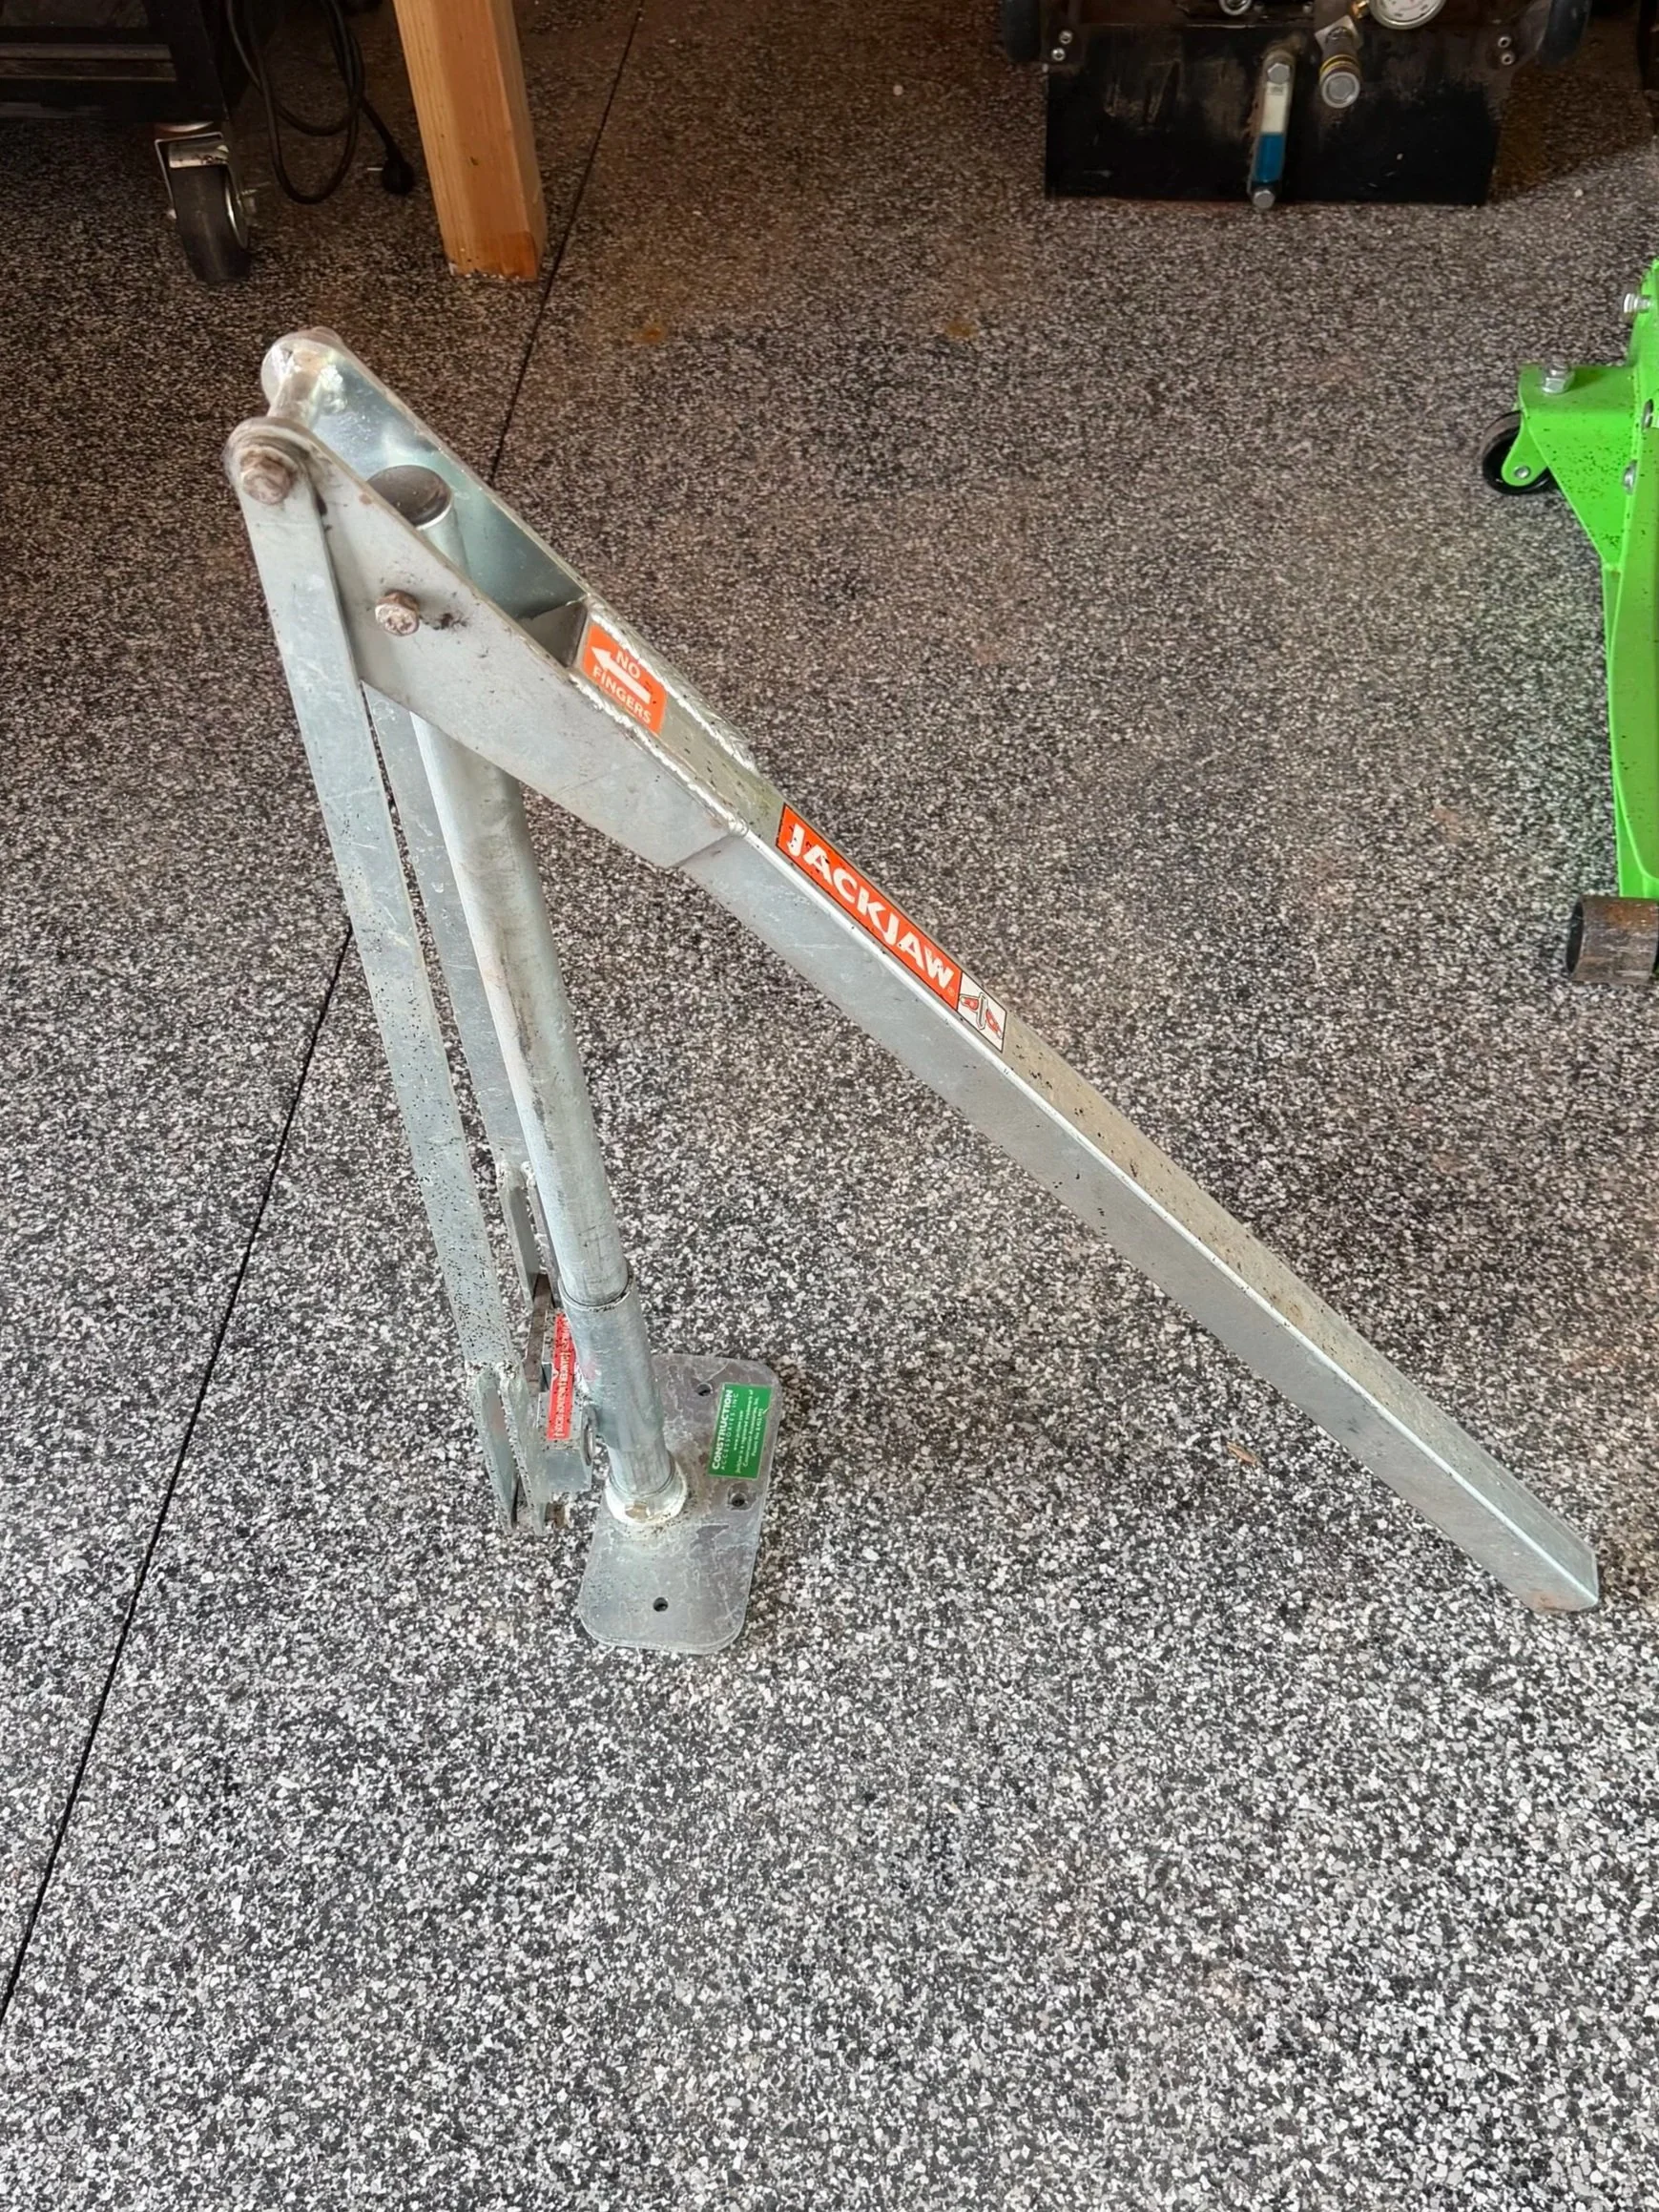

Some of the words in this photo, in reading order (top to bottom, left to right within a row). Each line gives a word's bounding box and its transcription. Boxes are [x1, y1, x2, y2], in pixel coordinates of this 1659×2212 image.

[592, 664, 653, 724] FINGERS
[615, 650, 641, 679] NO
[786, 823, 955, 990] JACKJAW
[712, 1389, 734, 1470] CONSTRUCTION
